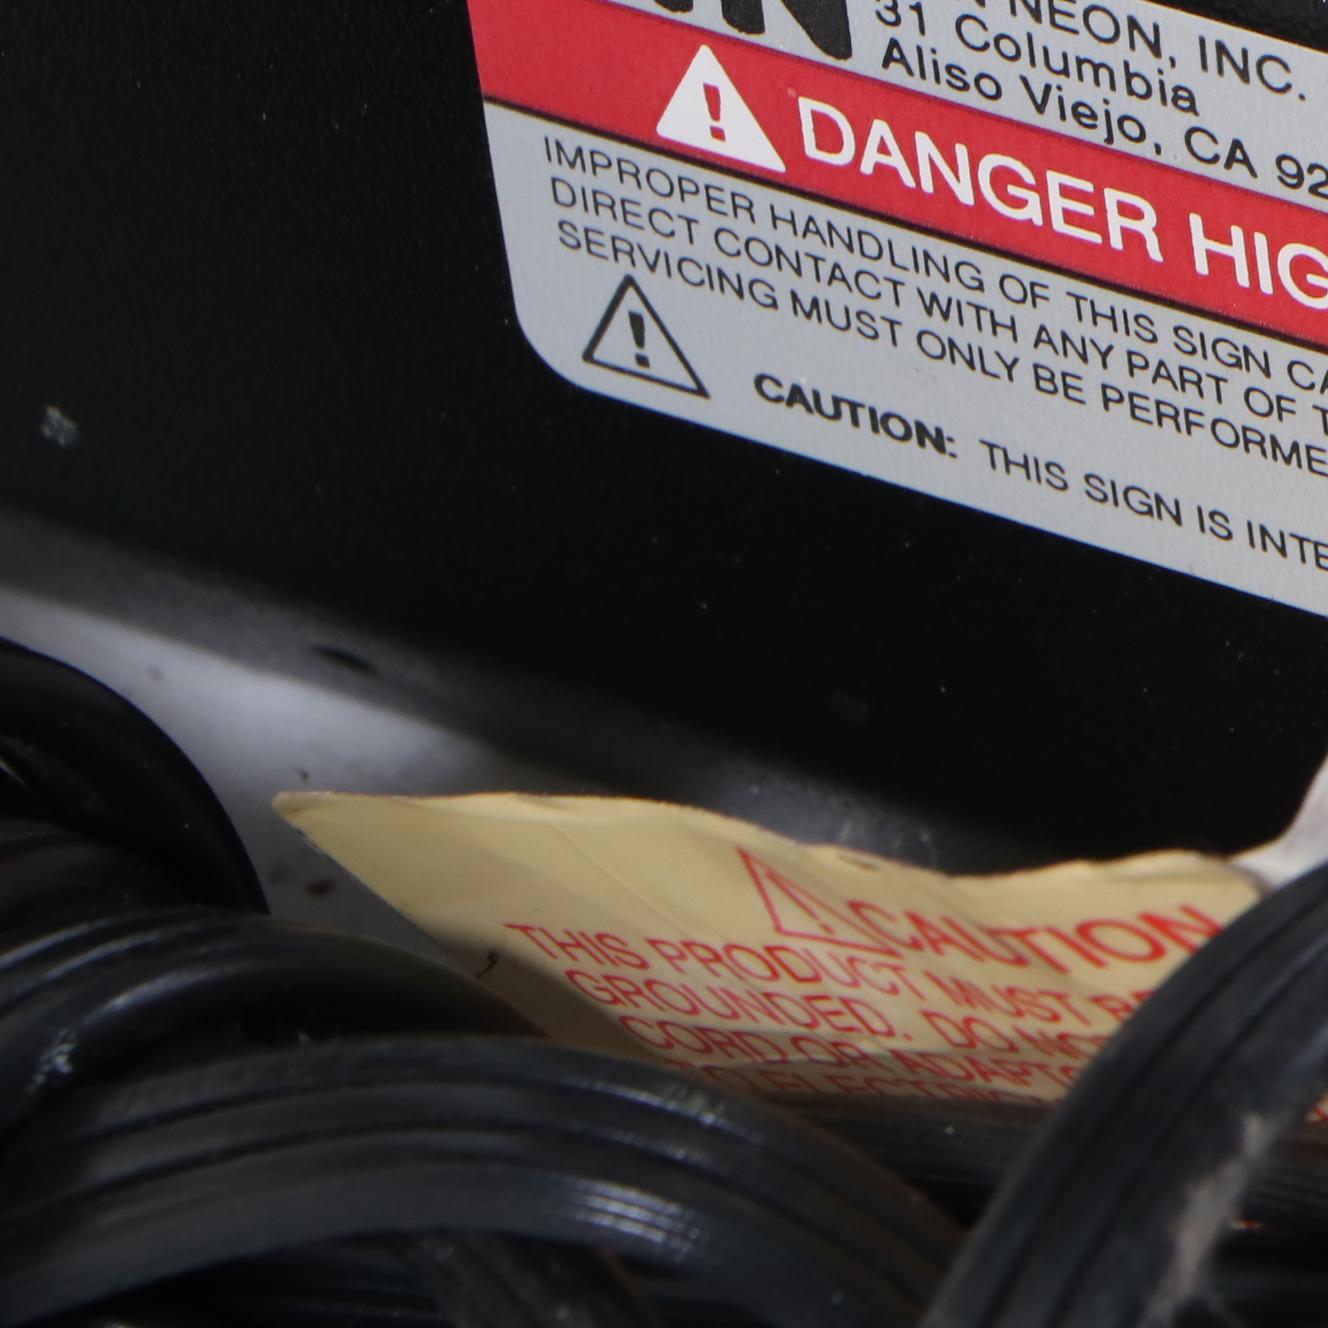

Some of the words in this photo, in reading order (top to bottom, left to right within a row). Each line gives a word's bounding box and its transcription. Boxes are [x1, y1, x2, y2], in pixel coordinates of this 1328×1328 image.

[881, 37, 1002, 101] Aliso
[1019, 74, 1164, 155] Viejo,
[1183, 126, 1259, 179] CA
[954, 13, 1201, 117] Columbia
[1198, 36, 1307, 101] INC.
[798, 96, 1164, 263] DANGER
[544, 136, 755, 223] IMPROPER
[770, 204, 985, 293] HANDLING
[999, 273, 1050, 309] OF
[1066, 292, 1159, 345] THIS
[1172, 324, 1271, 379] SIGN
[550, 177, 700, 246] DIRECT
[713, 228, 906, 307] CONTACT
[916, 288, 1017, 342] WITH
[1033, 323, 1115, 366] ANY
[1126, 350, 1228, 405] PART
[1244, 388, 1297, 422] OF
[557, 219, 780, 311] SERVICING
[791, 290, 902, 348] MUST
[916, 329, 1019, 383] ONLY
[1032, 362, 1087, 405] BE
[753, 373, 959, 459] CAUTION:
[978, 438, 1070, 493] THIS
[1084, 473, 1183, 528] SIGN
[1198, 506, 1234, 542] IS
[504, 922, 650, 971] THIS
[644, 938, 927, 1001] PRODUCT
[923, 969, 1093, 1026] MUST
[565, 969, 913, 1042] GROUNDED.
[919, 1010, 1020, 1054] DO
